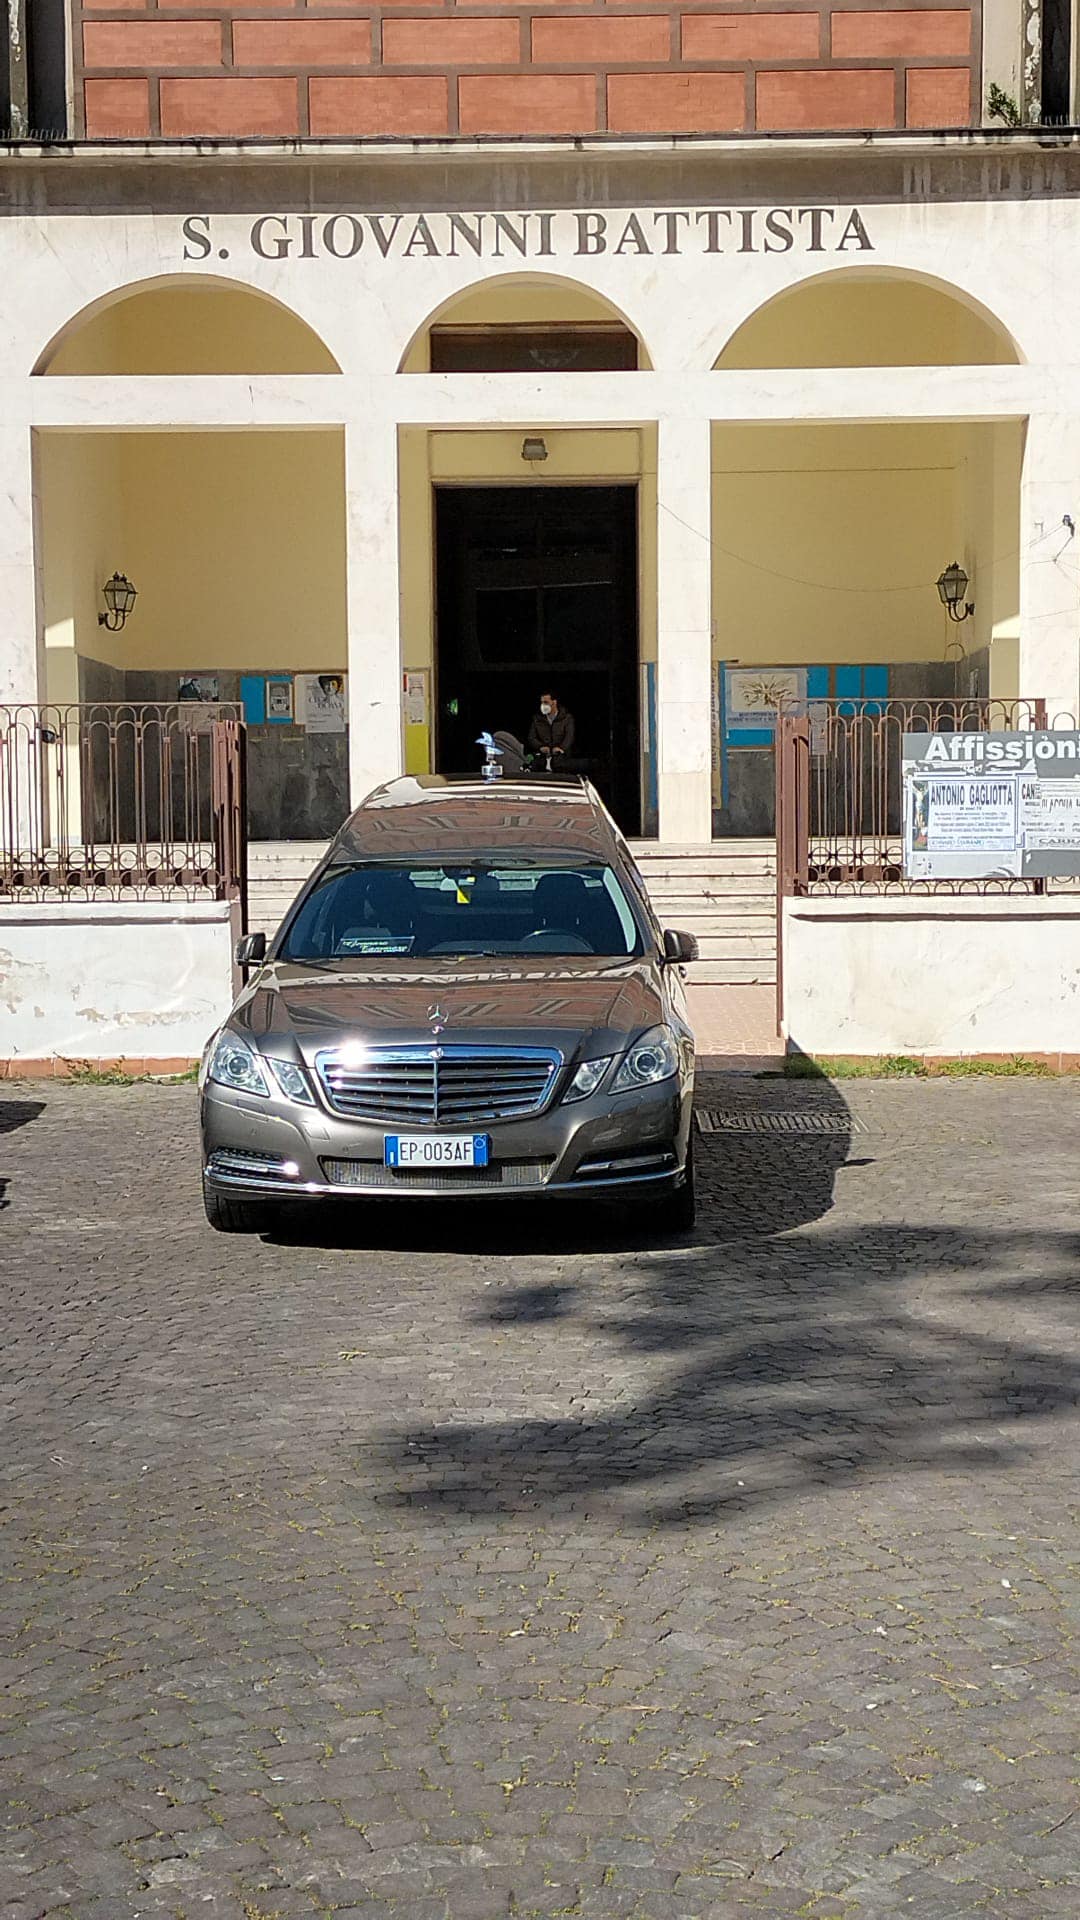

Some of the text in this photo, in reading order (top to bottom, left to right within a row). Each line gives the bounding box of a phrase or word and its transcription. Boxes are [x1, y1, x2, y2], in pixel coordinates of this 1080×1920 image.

[182, 208, 875, 260] S. GIOVANNI BATTISTA
[930, 784, 965, 806] ANTONIO
[969, 783, 1014, 806] GAGLIOTTA
[400, 1142, 418, 1161] EP
[424, 1141, 472, 1161] 003AF
